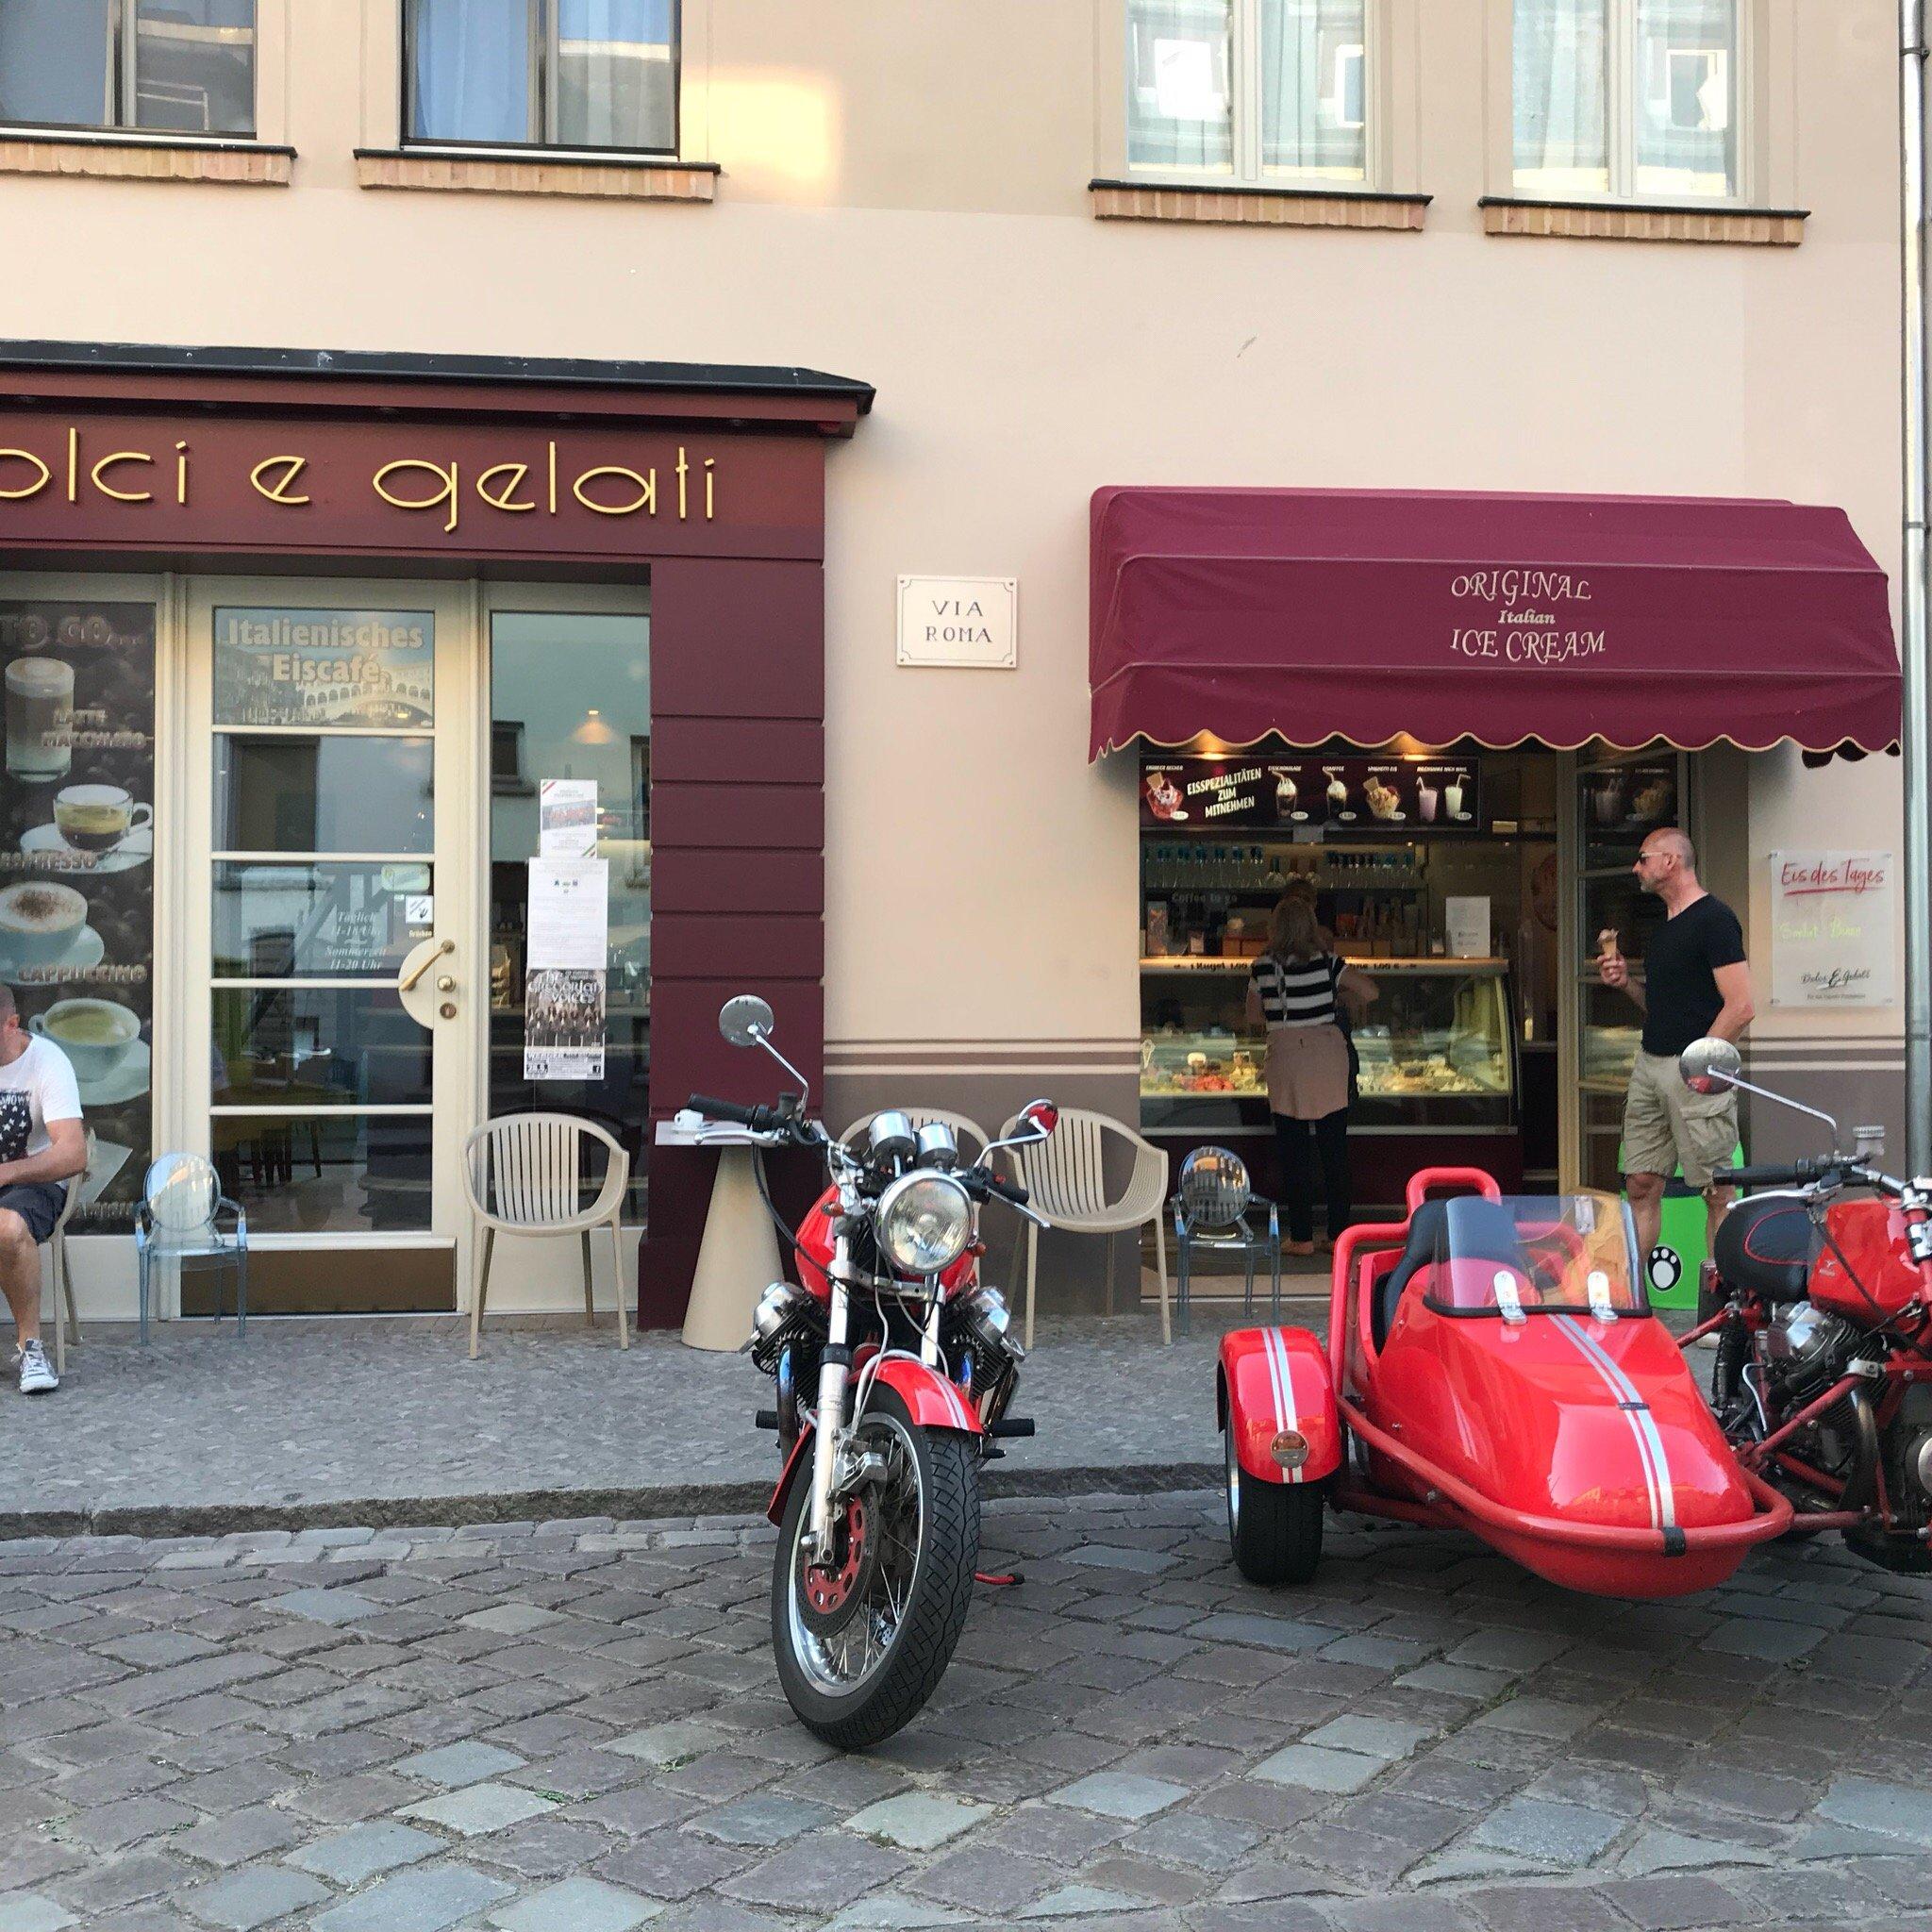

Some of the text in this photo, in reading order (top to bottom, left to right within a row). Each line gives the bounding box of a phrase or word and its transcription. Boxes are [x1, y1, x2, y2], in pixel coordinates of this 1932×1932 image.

[250, 455, 310, 504] e
[373, 441, 716, 533] gelati
[1451, 569, 1592, 607] ORIGINAL
[931, 600, 984, 617] VIA
[1497, 608, 1557, 625] Italian
[228, 617, 425, 649] Italienisches
[924, 625, 993, 643] ROMA
[1450, 628, 1607, 665] ICE CREAM
[273, 652, 381, 683] Eiscafé
[1187, 767, 1262, 796] EISSPEZIALITÄTEN
[1217, 786, 1237, 802] ZUM
[1205, 795, 1256, 818] MITNEHMEN
[1781, 857, 1886, 894] Eis des Tages
